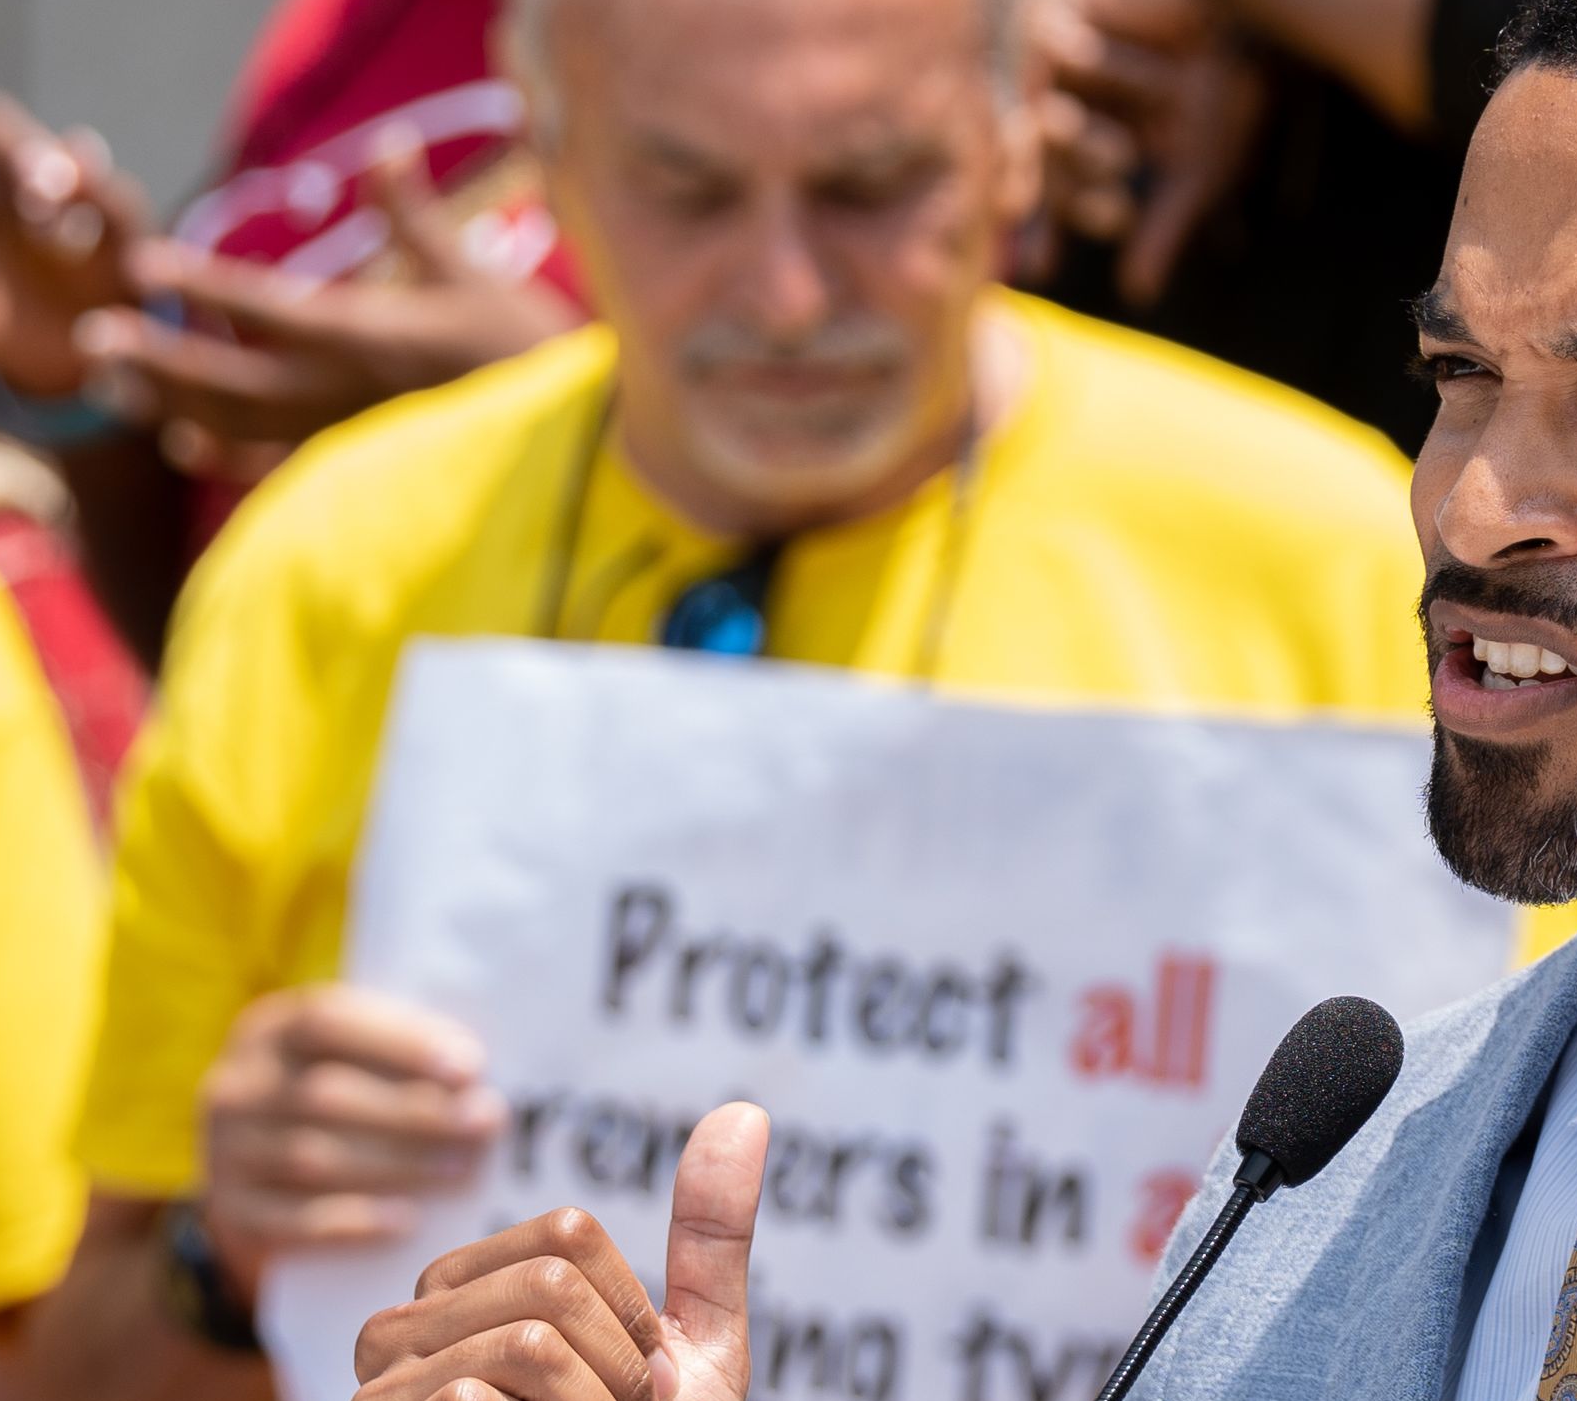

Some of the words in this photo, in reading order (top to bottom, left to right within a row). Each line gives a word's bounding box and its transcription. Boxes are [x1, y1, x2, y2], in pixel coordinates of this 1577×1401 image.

[603, 881, 1038, 1075] Protect
[1068, 936, 1220, 1095] all
[976, 1113, 1091, 1260] in
